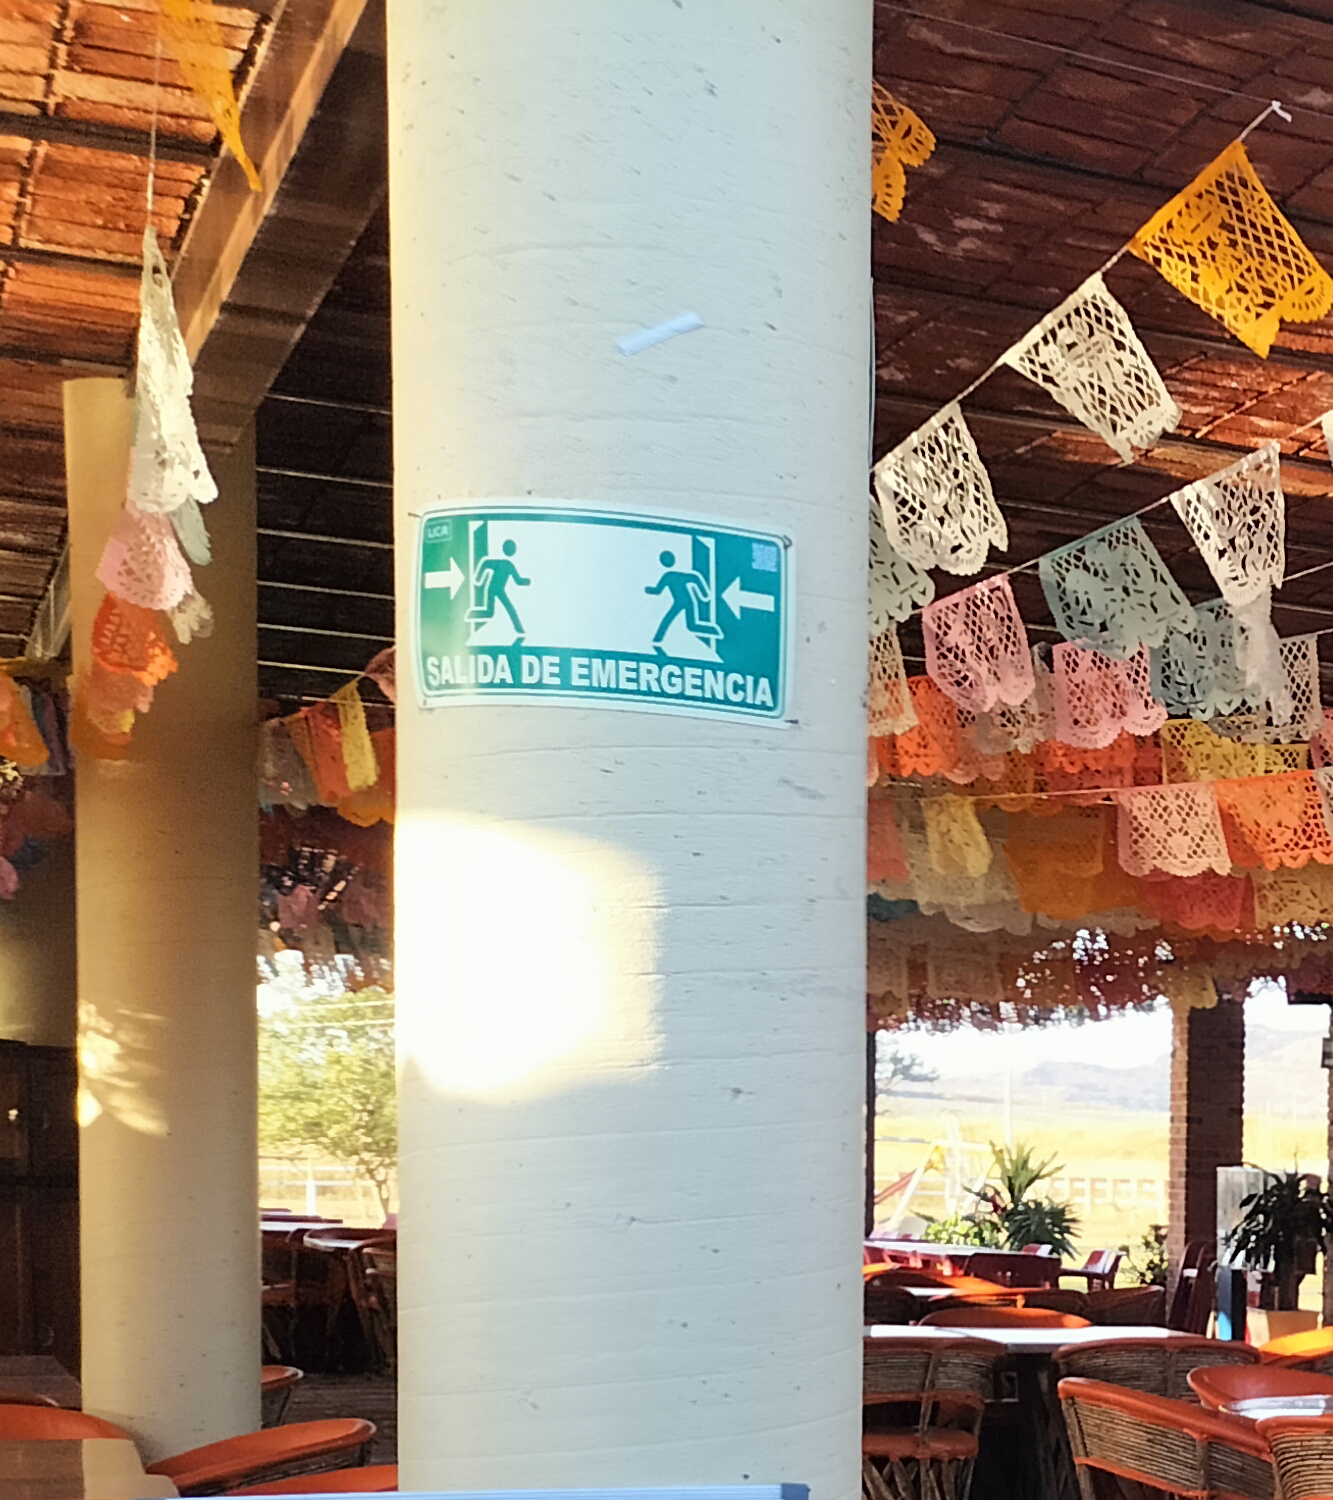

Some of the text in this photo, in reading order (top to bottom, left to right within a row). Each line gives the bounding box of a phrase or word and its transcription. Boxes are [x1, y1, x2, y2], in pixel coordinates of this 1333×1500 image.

[427, 654, 774, 707] SALIDA DE EMERGENCIA
